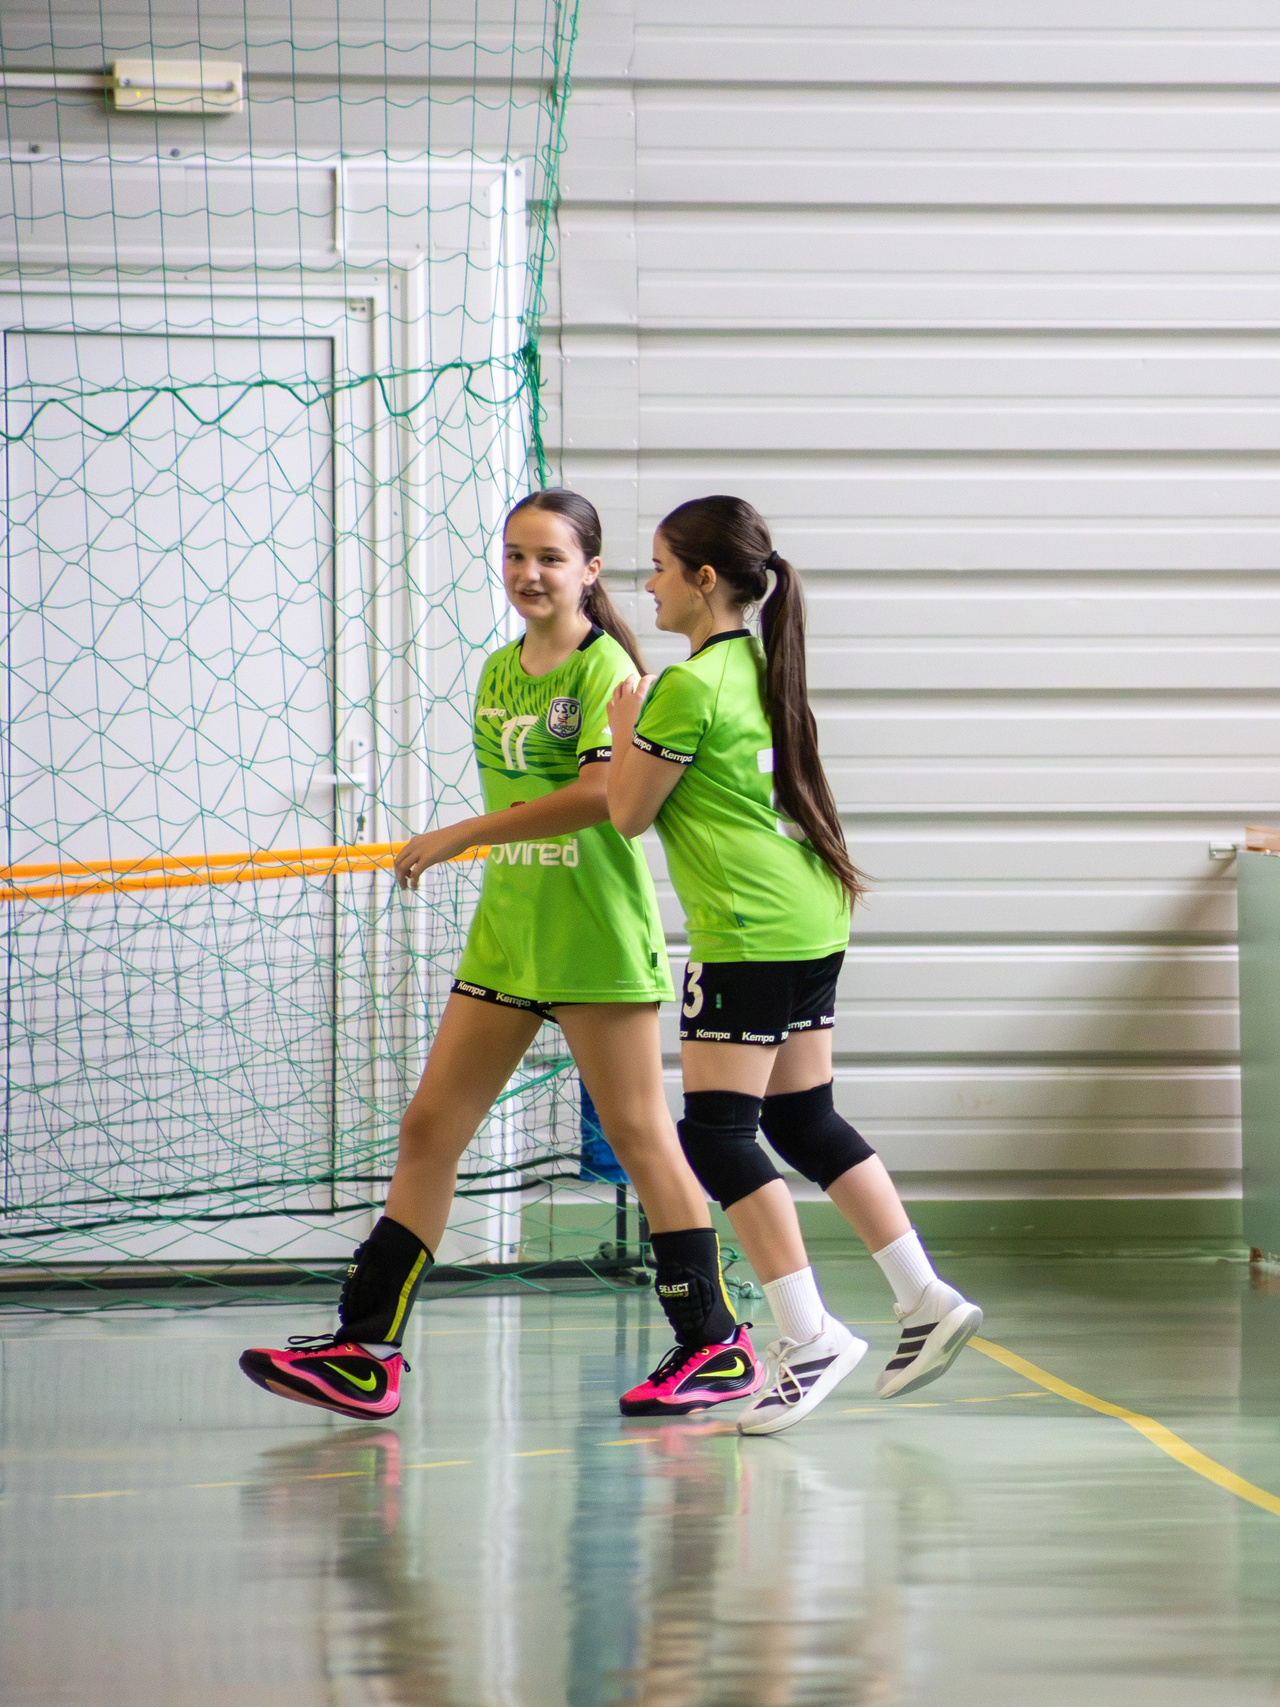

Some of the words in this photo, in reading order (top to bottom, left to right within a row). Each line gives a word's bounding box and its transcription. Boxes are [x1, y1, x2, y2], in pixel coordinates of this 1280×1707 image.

[554, 703, 578, 715] CSO
[660, 747, 694, 764] Kempa
[457, 981, 487, 997] Kempa
[495, 992, 532, 1007] Kempa
[696, 1028, 731, 1041] Kempa
[742, 1031, 775, 1044] Kempa
[659, 1283, 689, 1293] SELECT
